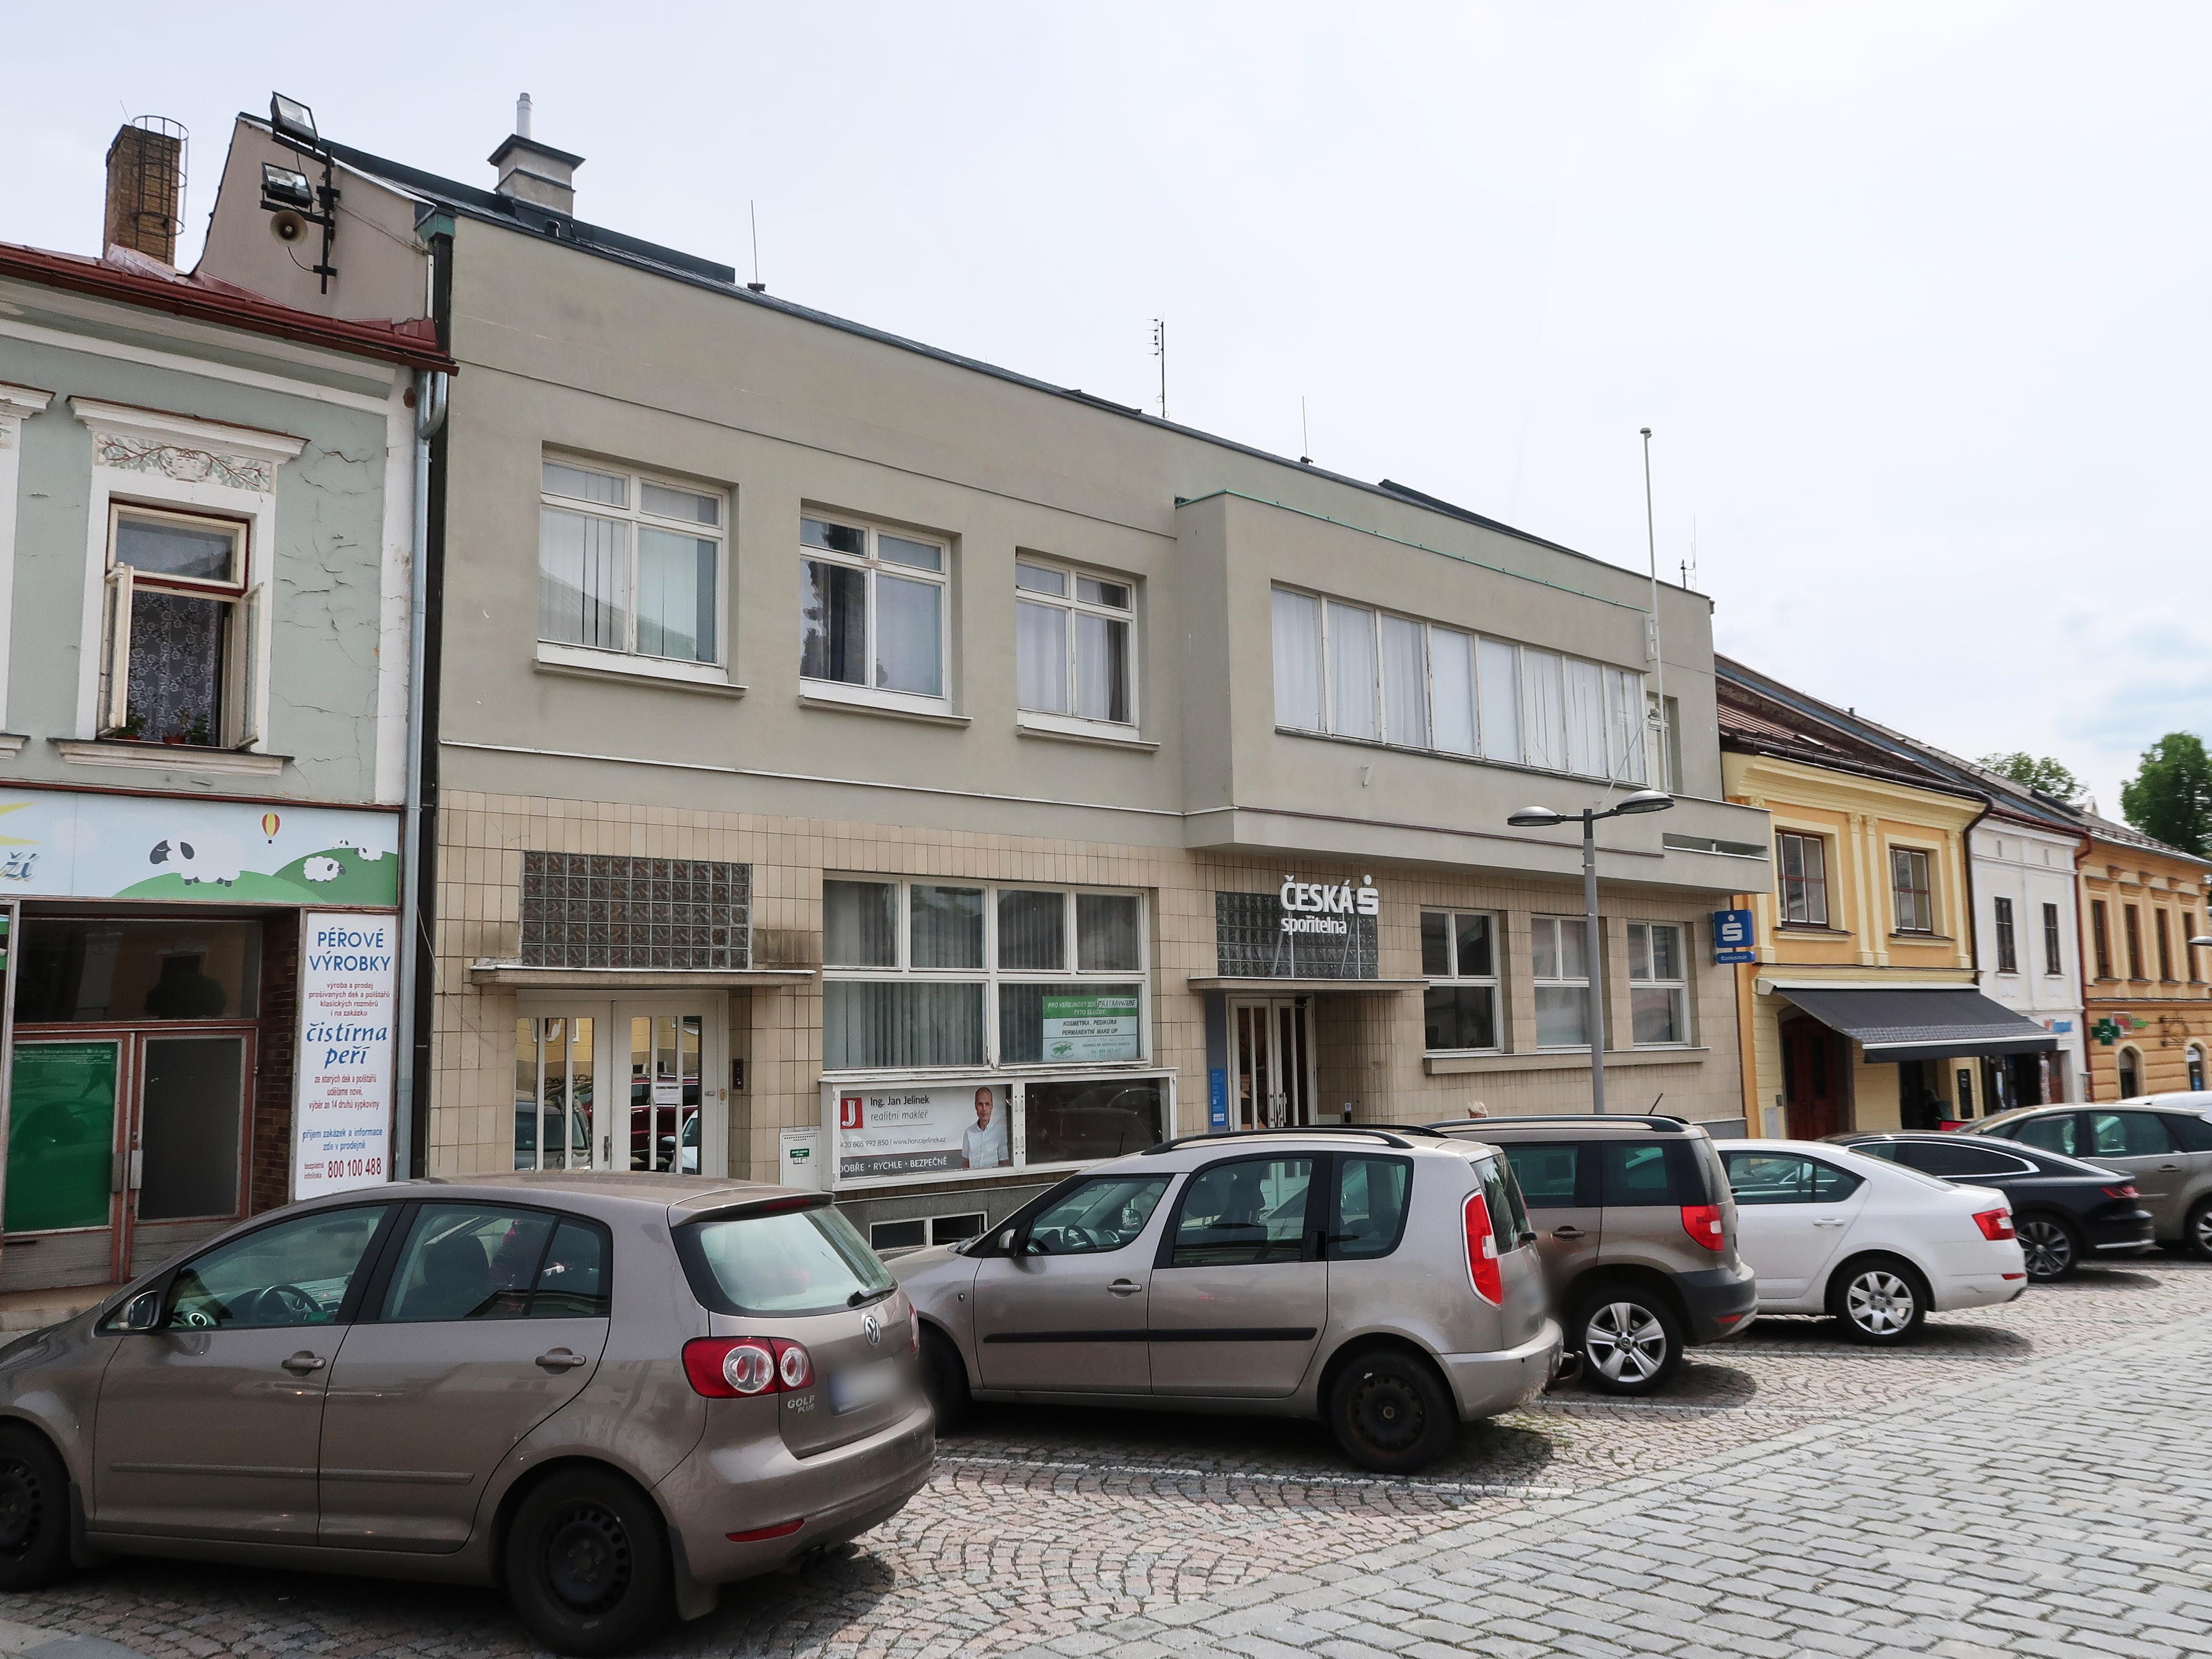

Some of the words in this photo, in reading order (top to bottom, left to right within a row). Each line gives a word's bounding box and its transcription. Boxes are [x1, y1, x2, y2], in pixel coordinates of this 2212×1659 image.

[1280, 874, 1354, 914] ČESKÁ
[1280, 915, 1347, 935] spořitelna
[317, 927, 383, 948] PÉŘOVÉ
[309, 951, 391, 971] VÝROBKY
[306, 1022, 387, 1042] čistírna
[324, 1046, 371, 1070] peří
[870, 1097, 885, 1108] Ing.
[888, 1097, 901, 1105] Jan
[903, 1094, 930, 1106] Jelínek
[870, 1110, 899, 1121] realitní
[901, 1109, 928, 1120] makléř
[323, 1128, 346, 1138] zakázek
[354, 1128, 383, 1136] informace
[323, 1142, 333, 1150] zde
[327, 1160, 344, 1178] 800
[347, 1159, 363, 1177] 100
[365, 1157, 382, 1176] 488
[873, 1161, 902, 1171] RYCHLE
[910, 1156, 947, 1168] BEZPEČNĚ
[787, 1395, 815, 1408] GOLF
[797, 1404, 815, 1413] PLUS
